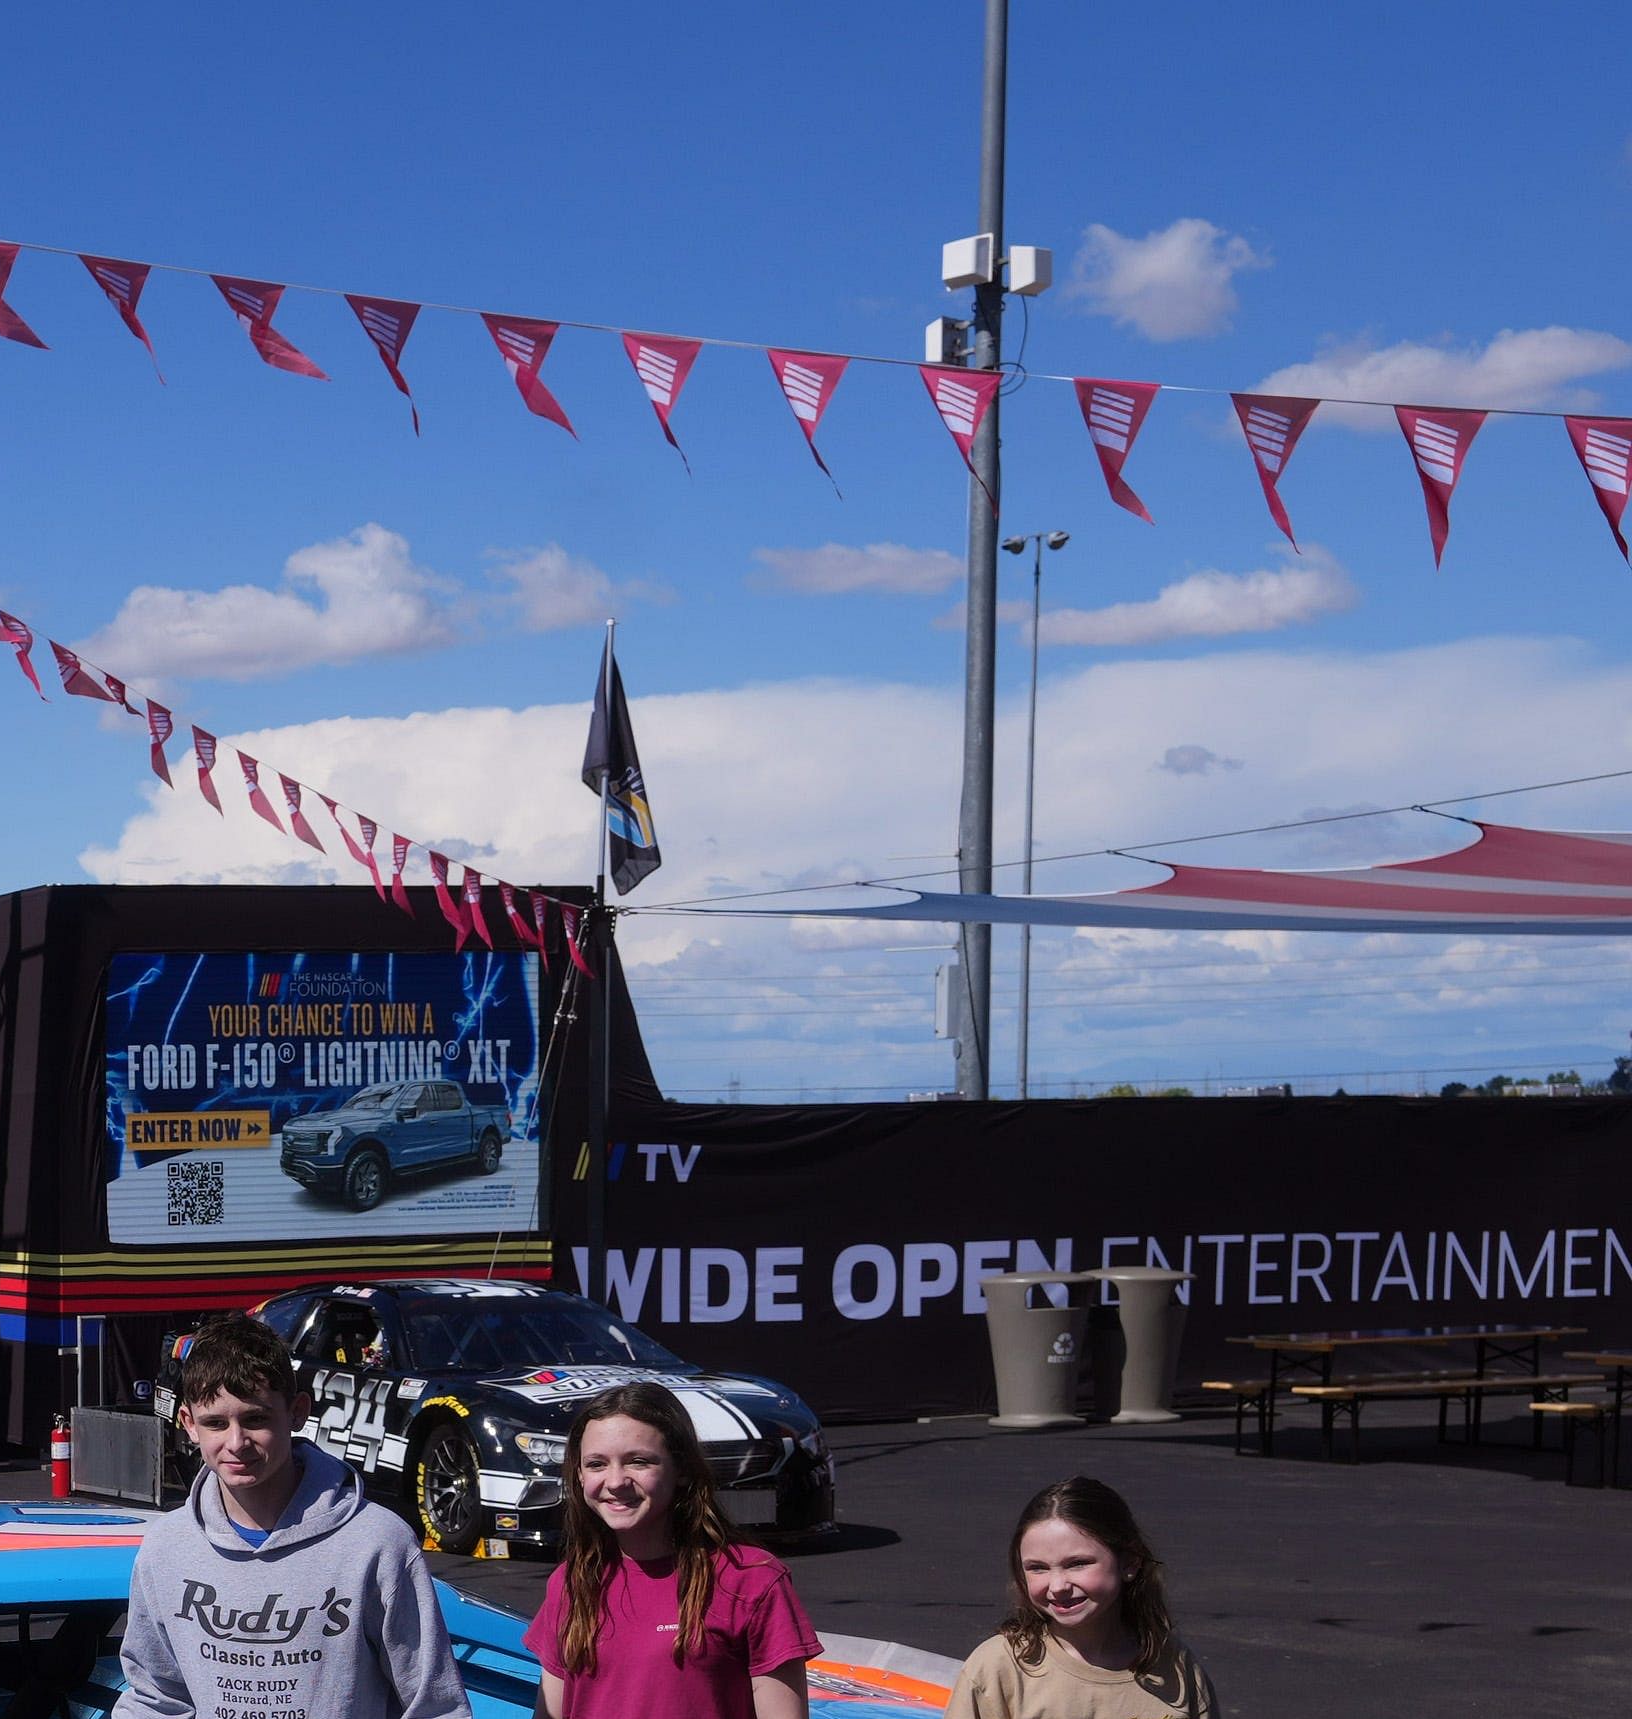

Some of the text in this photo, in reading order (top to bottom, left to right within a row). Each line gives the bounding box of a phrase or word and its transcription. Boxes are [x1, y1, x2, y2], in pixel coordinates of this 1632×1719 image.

[289, 981, 386, 997] FOUNDATION
[293, 973, 353, 982] THE NASCAR
[209, 1003, 435, 1038] YOUR CHANCE TO WIN A
[127, 1044, 196, 1091] FORD
[467, 1038, 512, 1084] XLT
[131, 1117, 242, 1145] ENTER NOW
[636, 1143, 703, 1183] TV
[570, 1246, 804, 1324] WIDE
[831, 1238, 1073, 1321] OPEN
[174, 1578, 352, 1644] Rudy's
[200, 1642, 323, 1667] Classic Auto
[216, 1676, 299, 1692] ZACK RUDY
[222, 1691, 292, 1705] Harvard, NE
